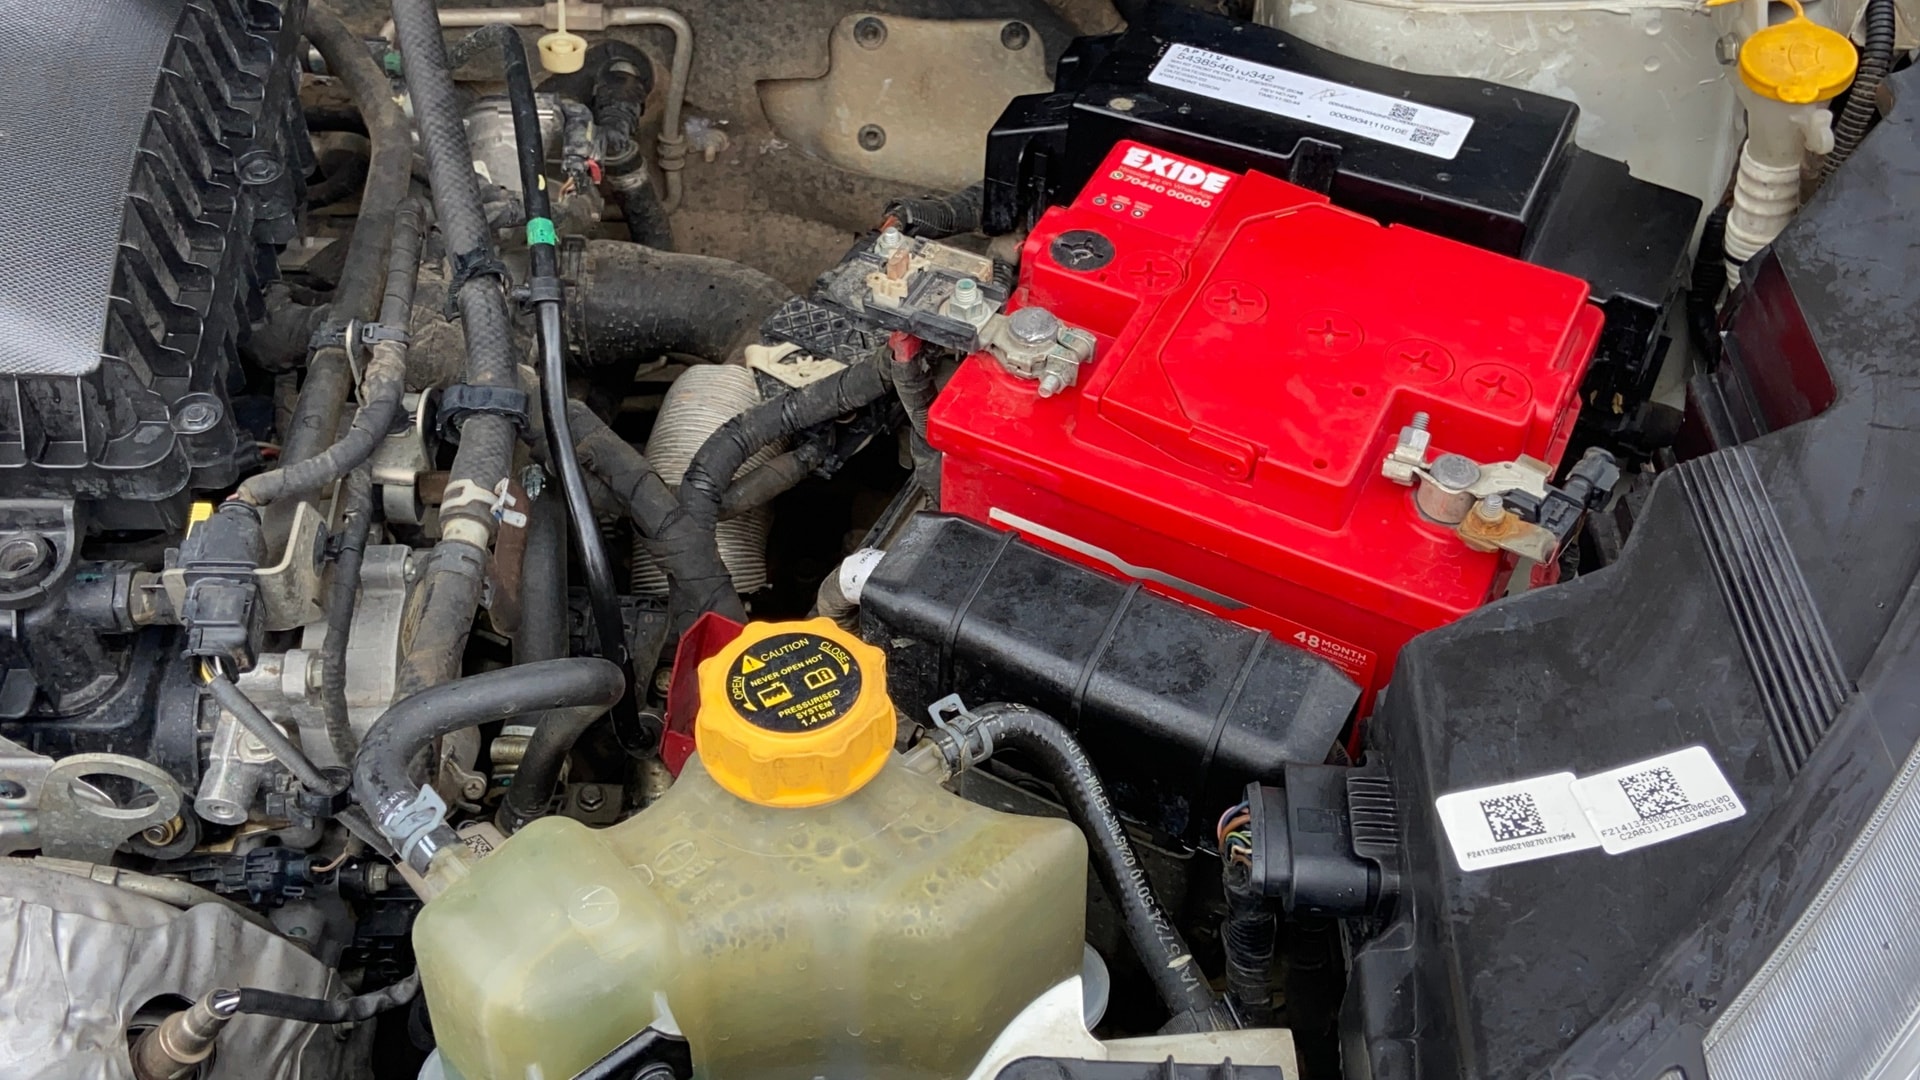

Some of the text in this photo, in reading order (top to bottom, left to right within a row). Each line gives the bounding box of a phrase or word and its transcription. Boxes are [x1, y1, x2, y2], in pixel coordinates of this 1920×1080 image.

[1122, 147, 1229, 193] EXIDE
[1124, 175, 1164, 193] 70440
[1167, 189, 1211, 207] 00000
[760, 637, 810, 662] CAUTION
[819, 641, 850, 665] CLOSE
[1293, 631, 1321, 648] 48
[1321, 639, 1366, 661] MONTH
[750, 654, 824, 687] NEVER OPEN HOT
[733, 675, 743, 701] OPEN
[778, 688, 841, 718] PRESSURISED
[796, 700, 833, 720] SYSTEM
[800, 708, 837, 727] 1.4 bar
